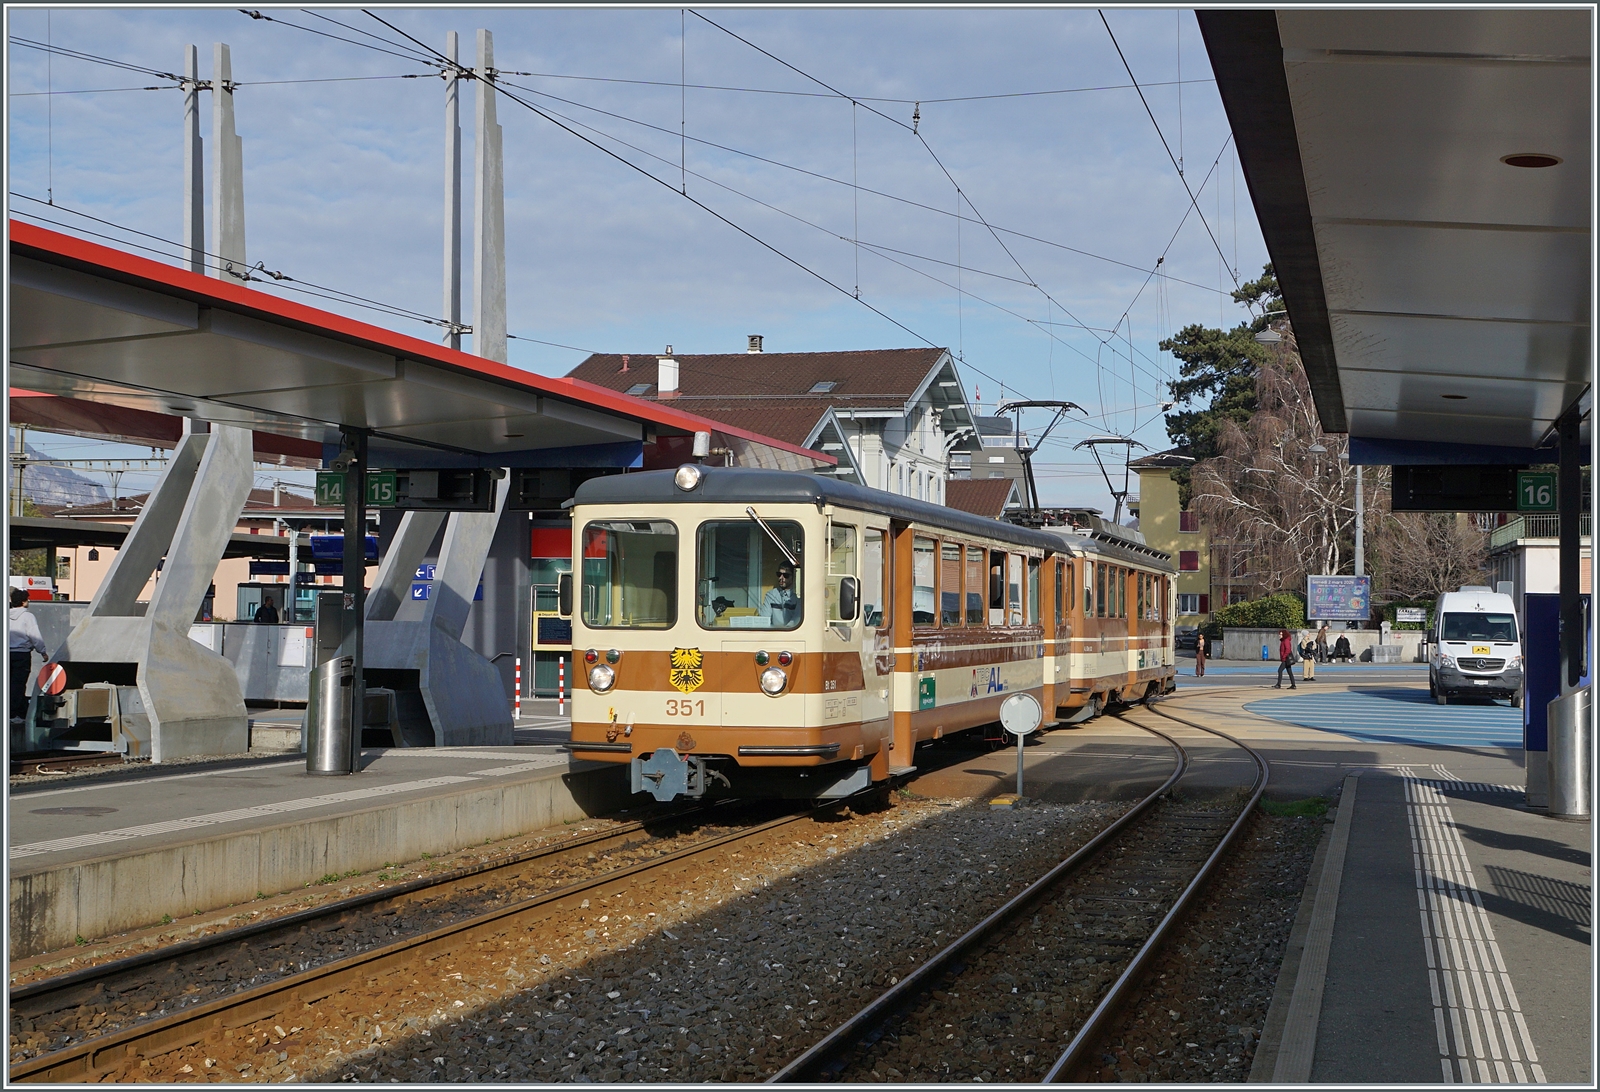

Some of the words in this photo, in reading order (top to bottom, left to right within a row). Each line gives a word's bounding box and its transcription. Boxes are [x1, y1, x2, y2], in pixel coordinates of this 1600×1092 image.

[320, 483, 341, 500] 14
[371, 483, 391, 500] 15
[1525, 485, 1550, 504] 16
[987, 667, 1003, 694] AL
[666, 699, 705, 717] 351
